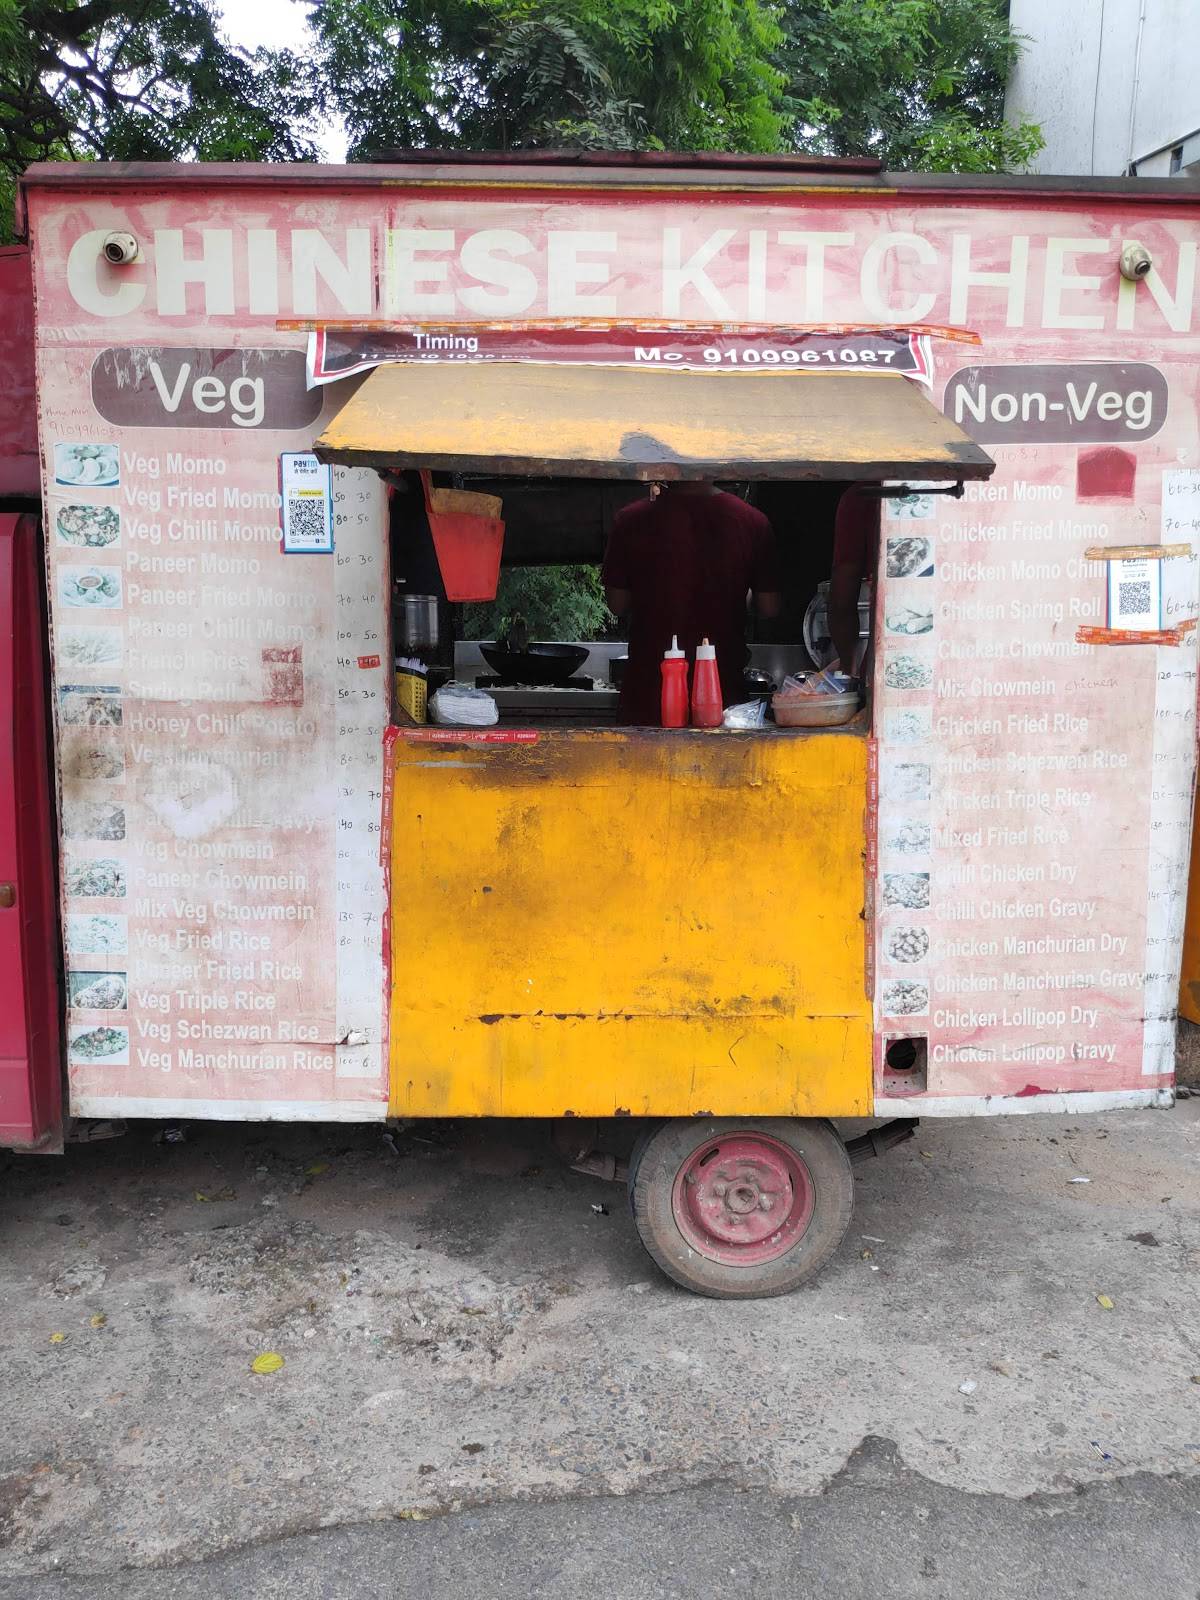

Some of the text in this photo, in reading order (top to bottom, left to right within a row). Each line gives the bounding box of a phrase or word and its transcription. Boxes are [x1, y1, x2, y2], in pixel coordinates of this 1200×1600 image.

[67, 228, 1197, 332] CHINESE KITCHEN
[412, 334, 478, 352] Timing
[634, 347, 896, 365] Mo. 9109961087
[148, 361, 265, 427] Veg
[954, 382, 1153, 430] Non-Veg
[124, 452, 226, 475] Veg Momo
[124, 487, 160, 509] Veg
[166, 487, 217, 508] Fried
[223, 487, 282, 508] Momo
[335, 492, 346, 503] 50
[940, 481, 1063, 503] icken Momo
[125, 519, 284, 543] Veg Chilli Momo
[940, 519, 1109, 543] Chicken Fried Momo
[126, 551, 261, 574] Paneer Momo
[940, 561, 1005, 583] Chicken
[1010, 560, 1062, 581] Momo
[127, 584, 317, 608] Paneer Fried Momo
[939, 596, 1101, 623] Chicken Spring Roll
[128, 616, 317, 640] Paneer Chilli Momo
[937, 637, 1095, 660] Chicken Chowmein
[201, 650, 249, 672] Fries
[937, 676, 1056, 698] Mix Chowmein
[130, 711, 190, 738] Honey
[197, 713, 245, 735] Chilli
[936, 713, 1089, 736] Chicken Fried Rice
[130, 743, 165, 765] Ve
[936, 750, 1129, 774] Chicken Schezwan Rice
[1006, 790, 1050, 812] Triple
[1055, 787, 1092, 808] Rice
[936, 826, 1071, 849] Mixed Fried Rice
[175, 840, 275, 860] Chowmein
[135, 866, 308, 890] Paneer Chowmein
[981, 863, 1045, 883] Chicken
[1050, 861, 1078, 886] Dry
[135, 898, 314, 923] Mix Veg Chowmein
[979, 899, 1044, 920] Chicken
[1049, 897, 1096, 921] Gravy
[135, 928, 271, 953] Veg Fried Rice
[934, 933, 1128, 959] Chicken Manchurian Dry
[207, 960, 255, 980] Fried
[260, 961, 304, 981] Rice
[934, 968, 1146, 994] Chicken Manchurian Gravy
[137, 990, 276, 1013] Veg Triple Rice
[933, 1005, 1098, 1030] Chicken Lollipop Dry
[137, 1019, 172, 1043] Veg
[176, 1020, 273, 1041] Schezwan
[278, 1020, 319, 1041] Rice
[137, 1049, 333, 1073] Veg Manchurian Rice
[932, 1041, 1117, 1066] Chicken Lollipop Gravy
